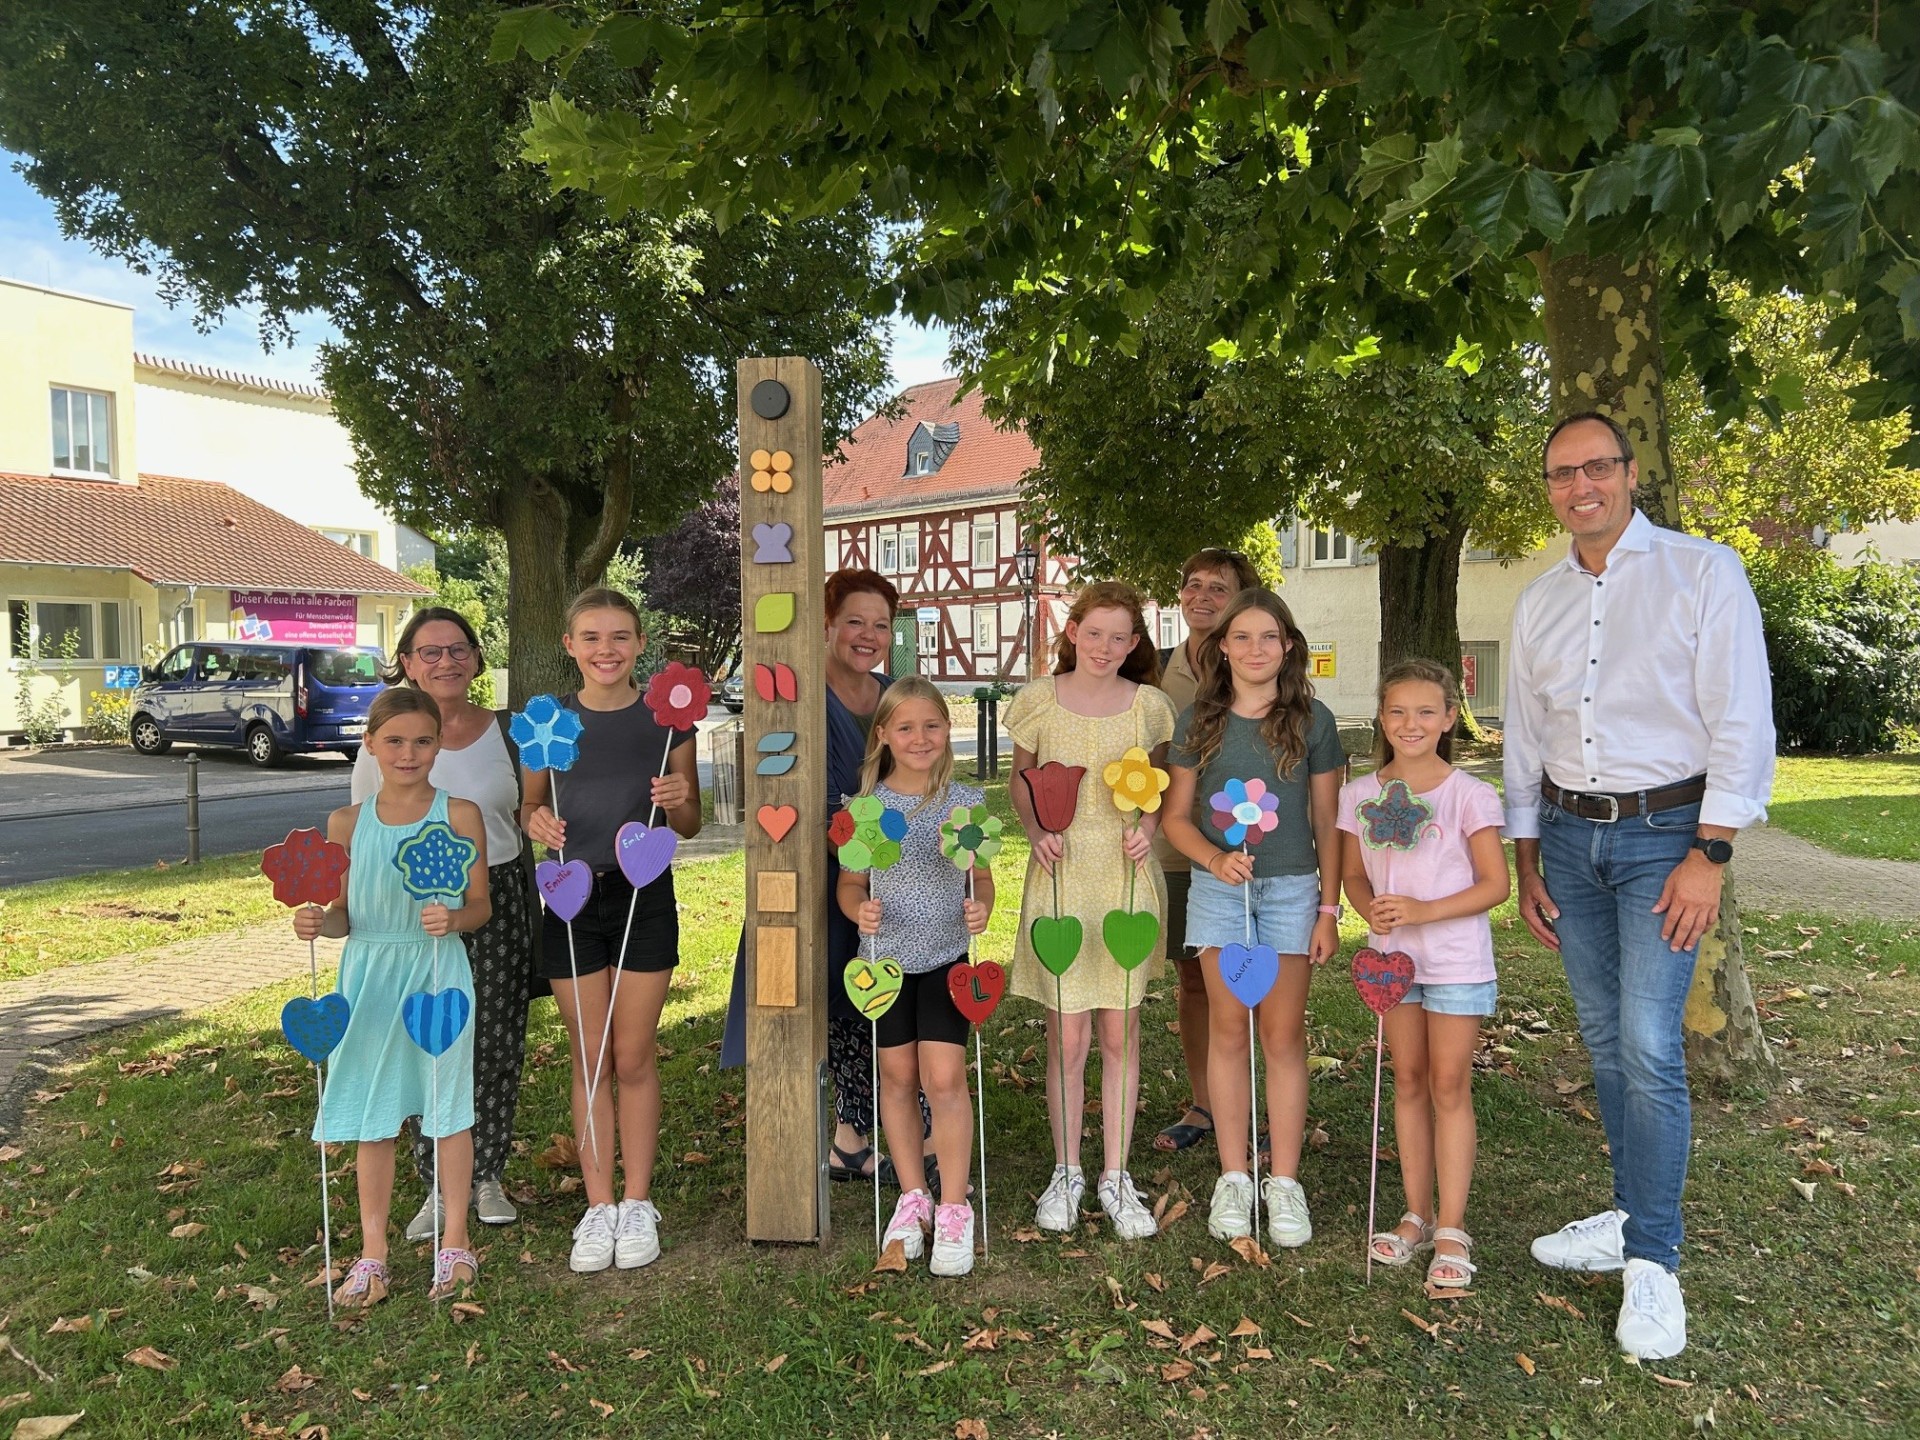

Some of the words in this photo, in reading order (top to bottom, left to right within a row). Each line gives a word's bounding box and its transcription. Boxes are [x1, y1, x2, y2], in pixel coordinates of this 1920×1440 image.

[234, 593, 261, 604] Unser
[264, 594, 289, 605] Kreuz
[291, 595, 305, 605] hat
[307, 595, 323, 606] alle
[324, 596, 355, 607] Farben!
[397, 609, 410, 621] 37
[285, 631, 298, 639] eine
[299, 631, 317, 639] offene
[106, 670, 117, 684] P
[1228, 956, 1253, 984] Laura
[971, 975, 991, 1003] L
